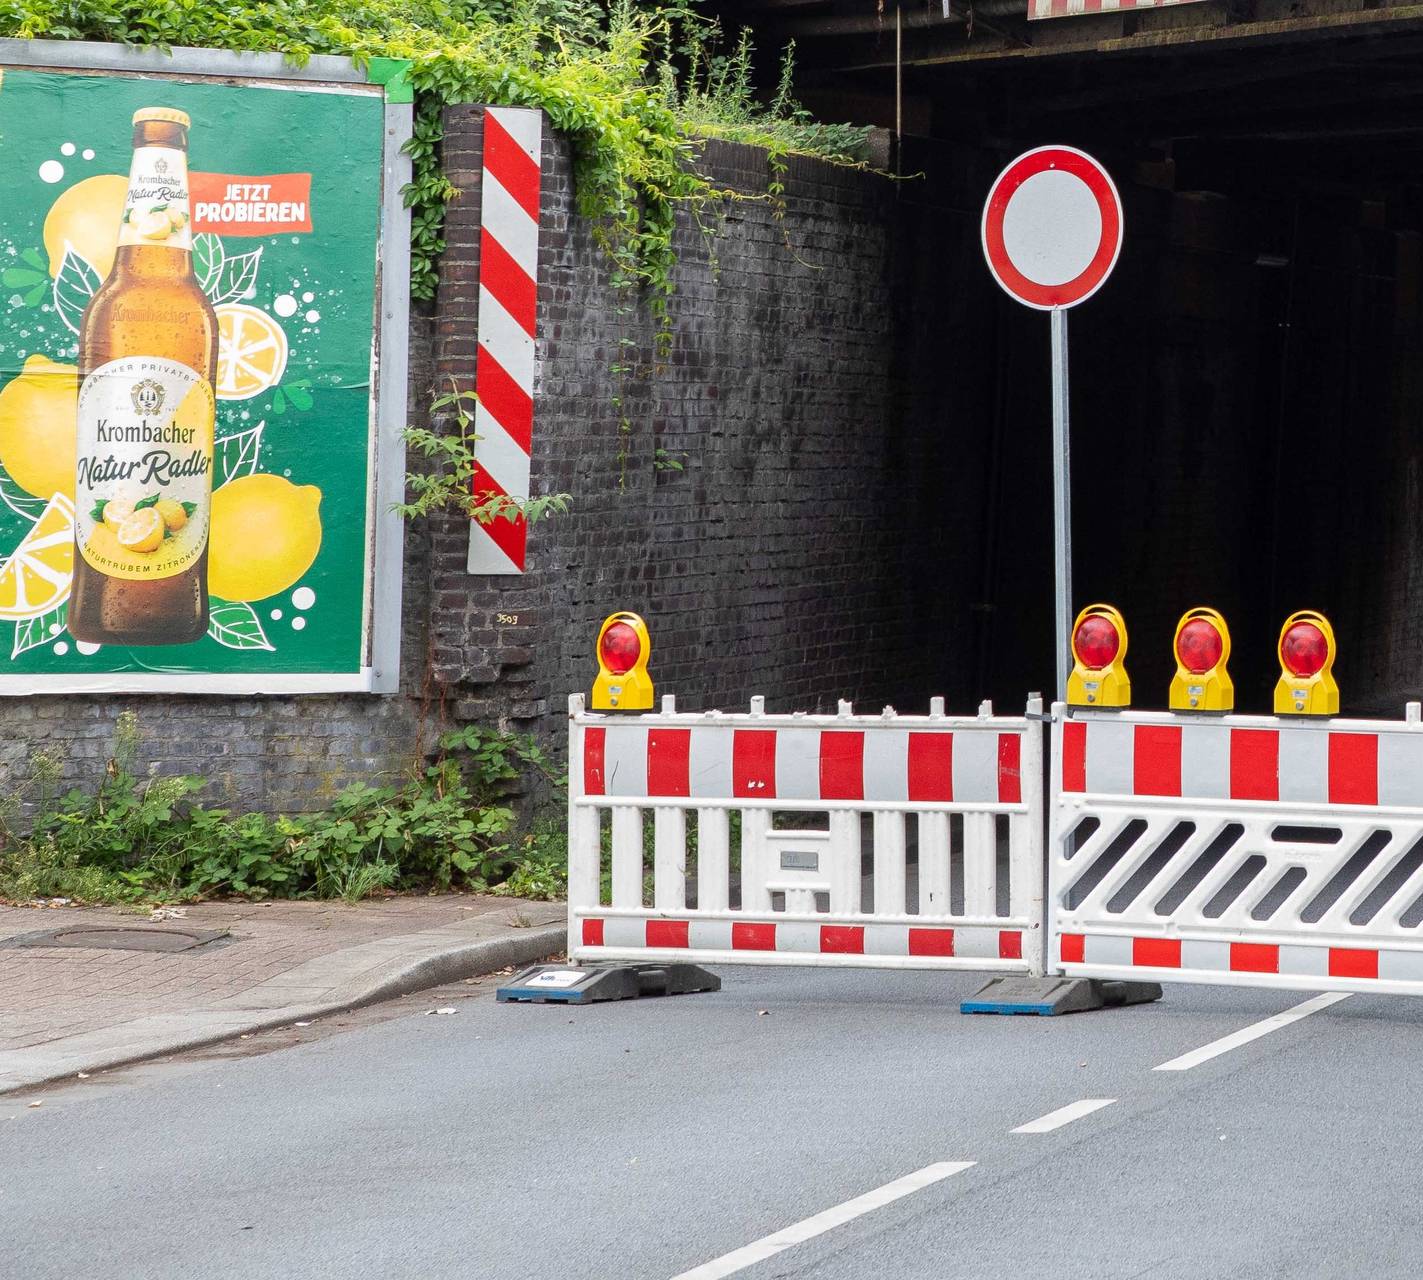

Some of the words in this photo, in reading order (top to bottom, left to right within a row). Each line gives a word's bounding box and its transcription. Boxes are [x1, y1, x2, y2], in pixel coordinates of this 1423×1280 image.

[138, 175, 181, 186] Krombacher
[128, 188, 158, 203] Natur
[223, 184, 272, 201] JETZT
[195, 202, 305, 223] PROBIEREN
[97, 419, 196, 444] Krombacher
[78, 454, 141, 491] Natur
[140, 449, 212, 486] Radler
